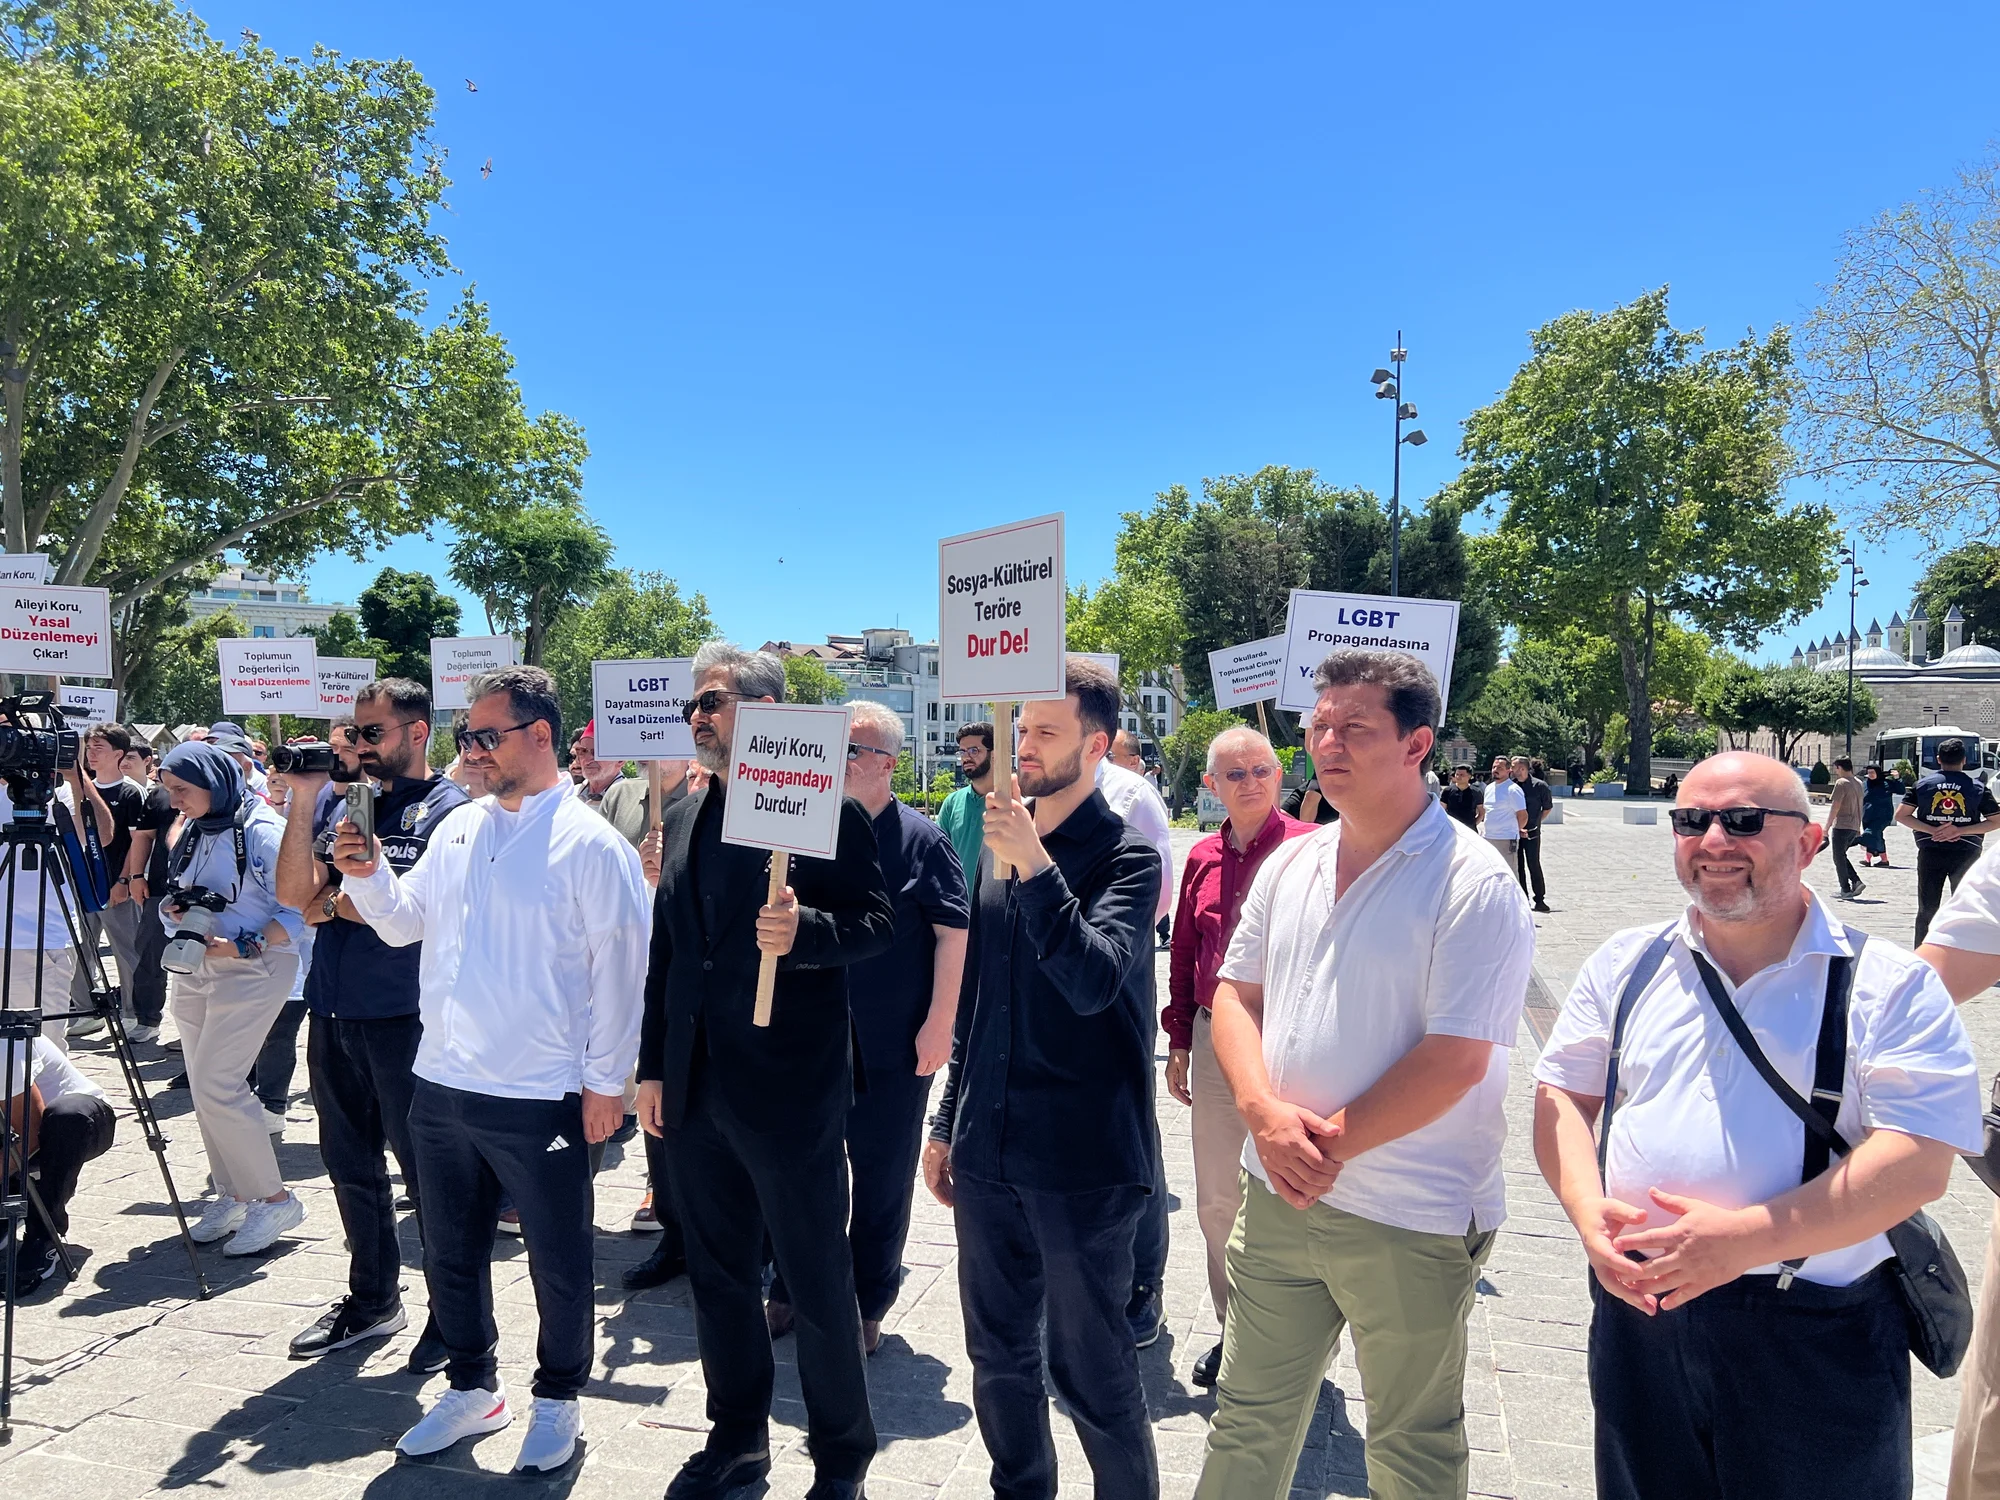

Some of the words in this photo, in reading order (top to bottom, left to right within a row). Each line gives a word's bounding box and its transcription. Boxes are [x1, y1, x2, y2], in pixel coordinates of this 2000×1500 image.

[13, 571, 36, 580] Koru,
[948, 557, 1053, 596] Sosya-Kültürel
[14, 598, 48, 612] Aileyi
[50, 600, 82, 614] Koru,
[974, 597, 1022, 622] Teröre
[28, 615, 70, 628] Yasal
[1337, 607, 1400, 629] LGBT
[1, 628, 98, 646] Düzenlemeyi
[967, 634, 998, 658] Dur
[1000, 628, 1029, 655] De!
[1308, 629, 1430, 652] Propagandasına
[32, 648, 68, 660] Çıkar!
[244, 652, 292, 662] Toplumun
[452, 649, 492, 660] Toplumun
[1233, 650, 1268, 664] Okullarda
[238, 664, 281, 675] Değerleri
[282, 663, 300, 674] İçin
[446, 660, 482, 672] Değerleri
[483, 660, 498, 670] İçin
[1218, 662, 1256, 678] Toplumsal
[230, 678, 257, 687] Yasal
[257, 677, 311, 687] Düzenleme
[1231, 668, 1277, 685] Misyonerliği
[322, 682, 350, 691] Teröre
[628, 678, 670, 692] LGBT
[1233, 678, 1279, 695] İstemiyoruz!
[68, 695, 95, 704] LGBT
[260, 690, 282, 700] Şart!
[336, 694, 354, 704] De!
[605, 699, 670, 711] Dayatmasına
[608, 715, 637, 725] Yasal
[640, 730, 664, 743] Şart!
[749, 735, 788, 759] Aileyi
[789, 738, 827, 763] Koru,
[737, 762, 833, 793] Propagandayı
[754, 792, 807, 817] Durdur!
[236, 828, 244, 855] SONY
